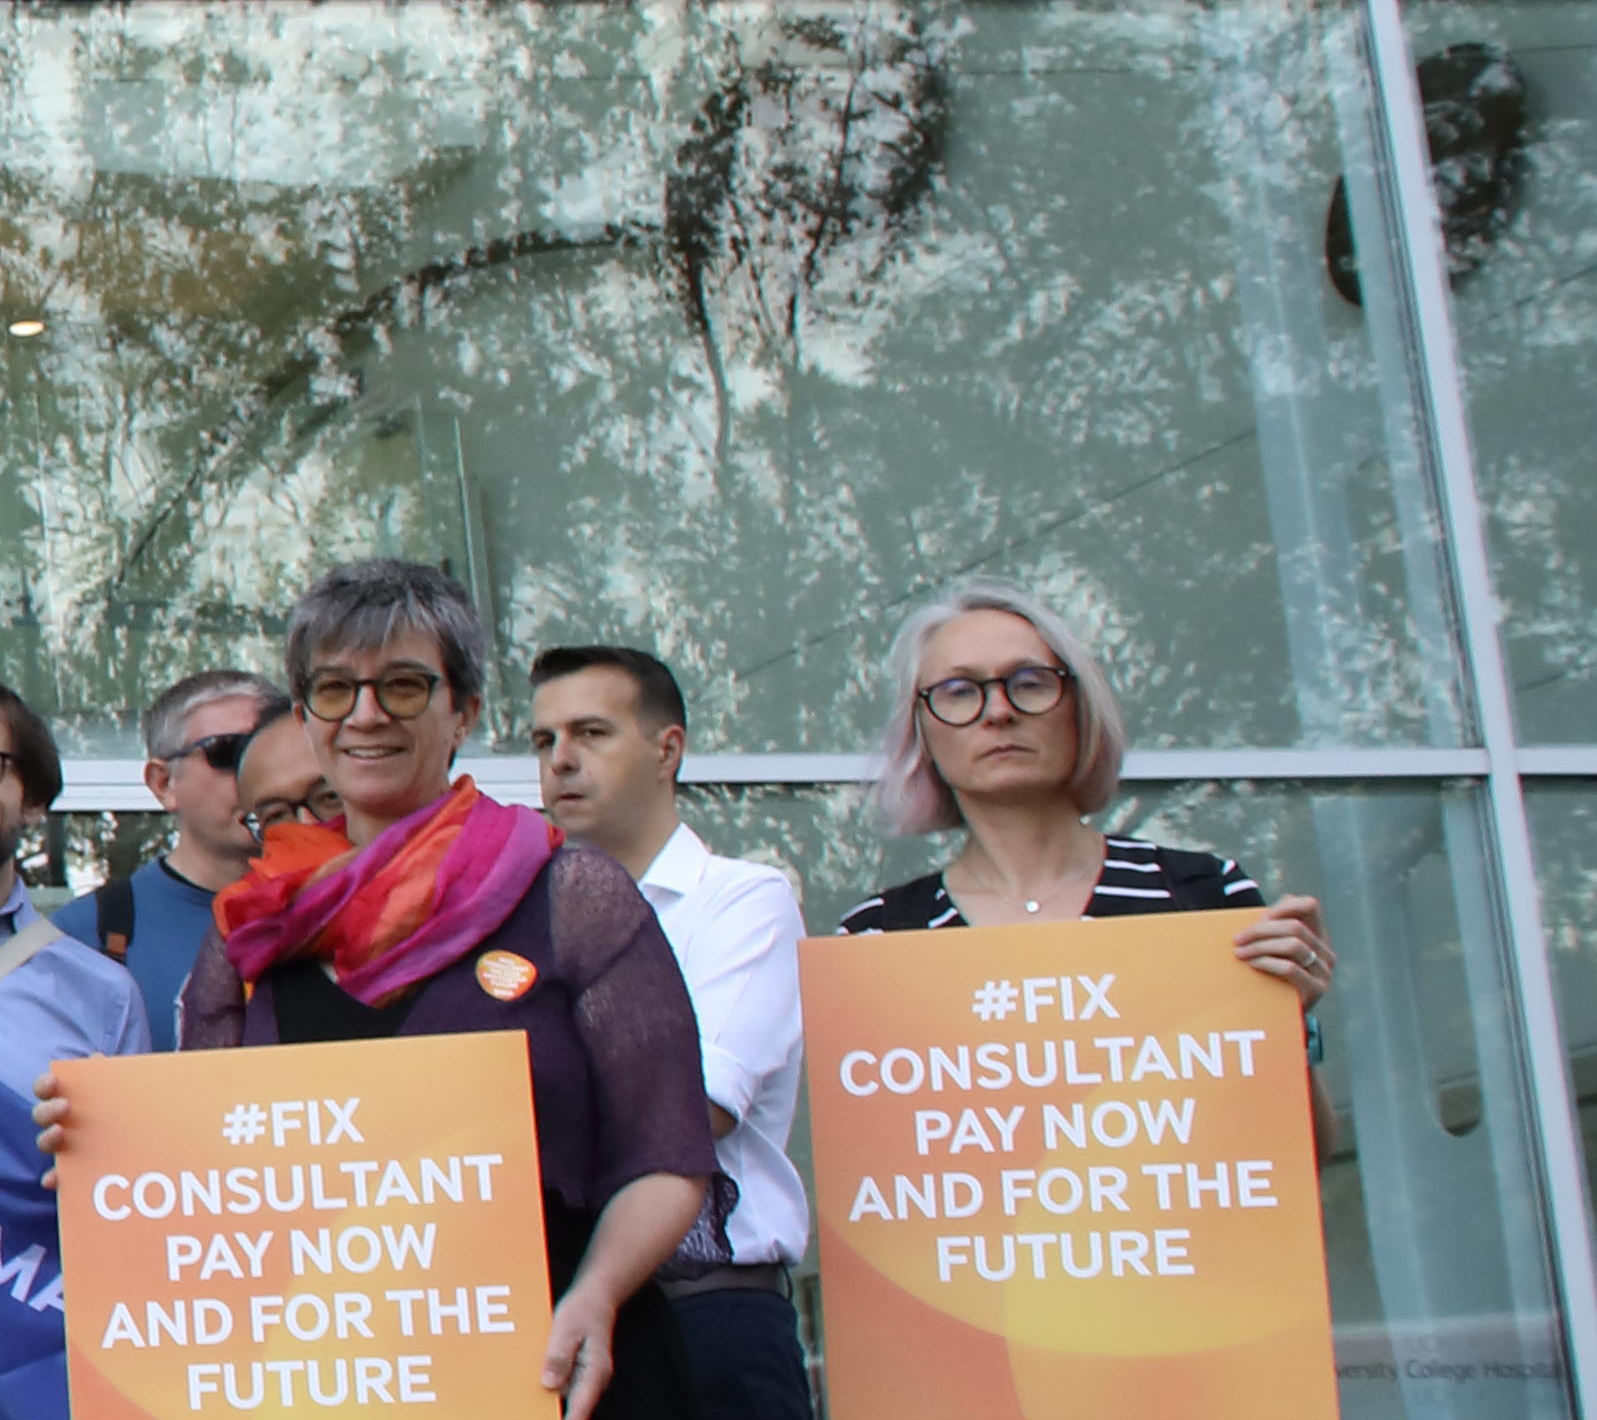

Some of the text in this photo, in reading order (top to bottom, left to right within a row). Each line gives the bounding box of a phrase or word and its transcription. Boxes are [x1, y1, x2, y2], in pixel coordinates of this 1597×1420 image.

[970, 973, 1120, 1024] #FIX
[838, 1029, 1266, 1098] CONSULTANT
[220, 1096, 364, 1148] #FIX
[913, 1097, 1196, 1157] PAY NOW
[91, 1153, 504, 1221] CONSULTANT
[848, 1159, 1279, 1223] AND FOR THE
[164, 1222, 437, 1282] PAY NOW
[935, 1227, 1196, 1283] FUTURE
[100, 1284, 515, 1349] AND FOR THE
[186, 1354, 437, 1411] FUTURE
